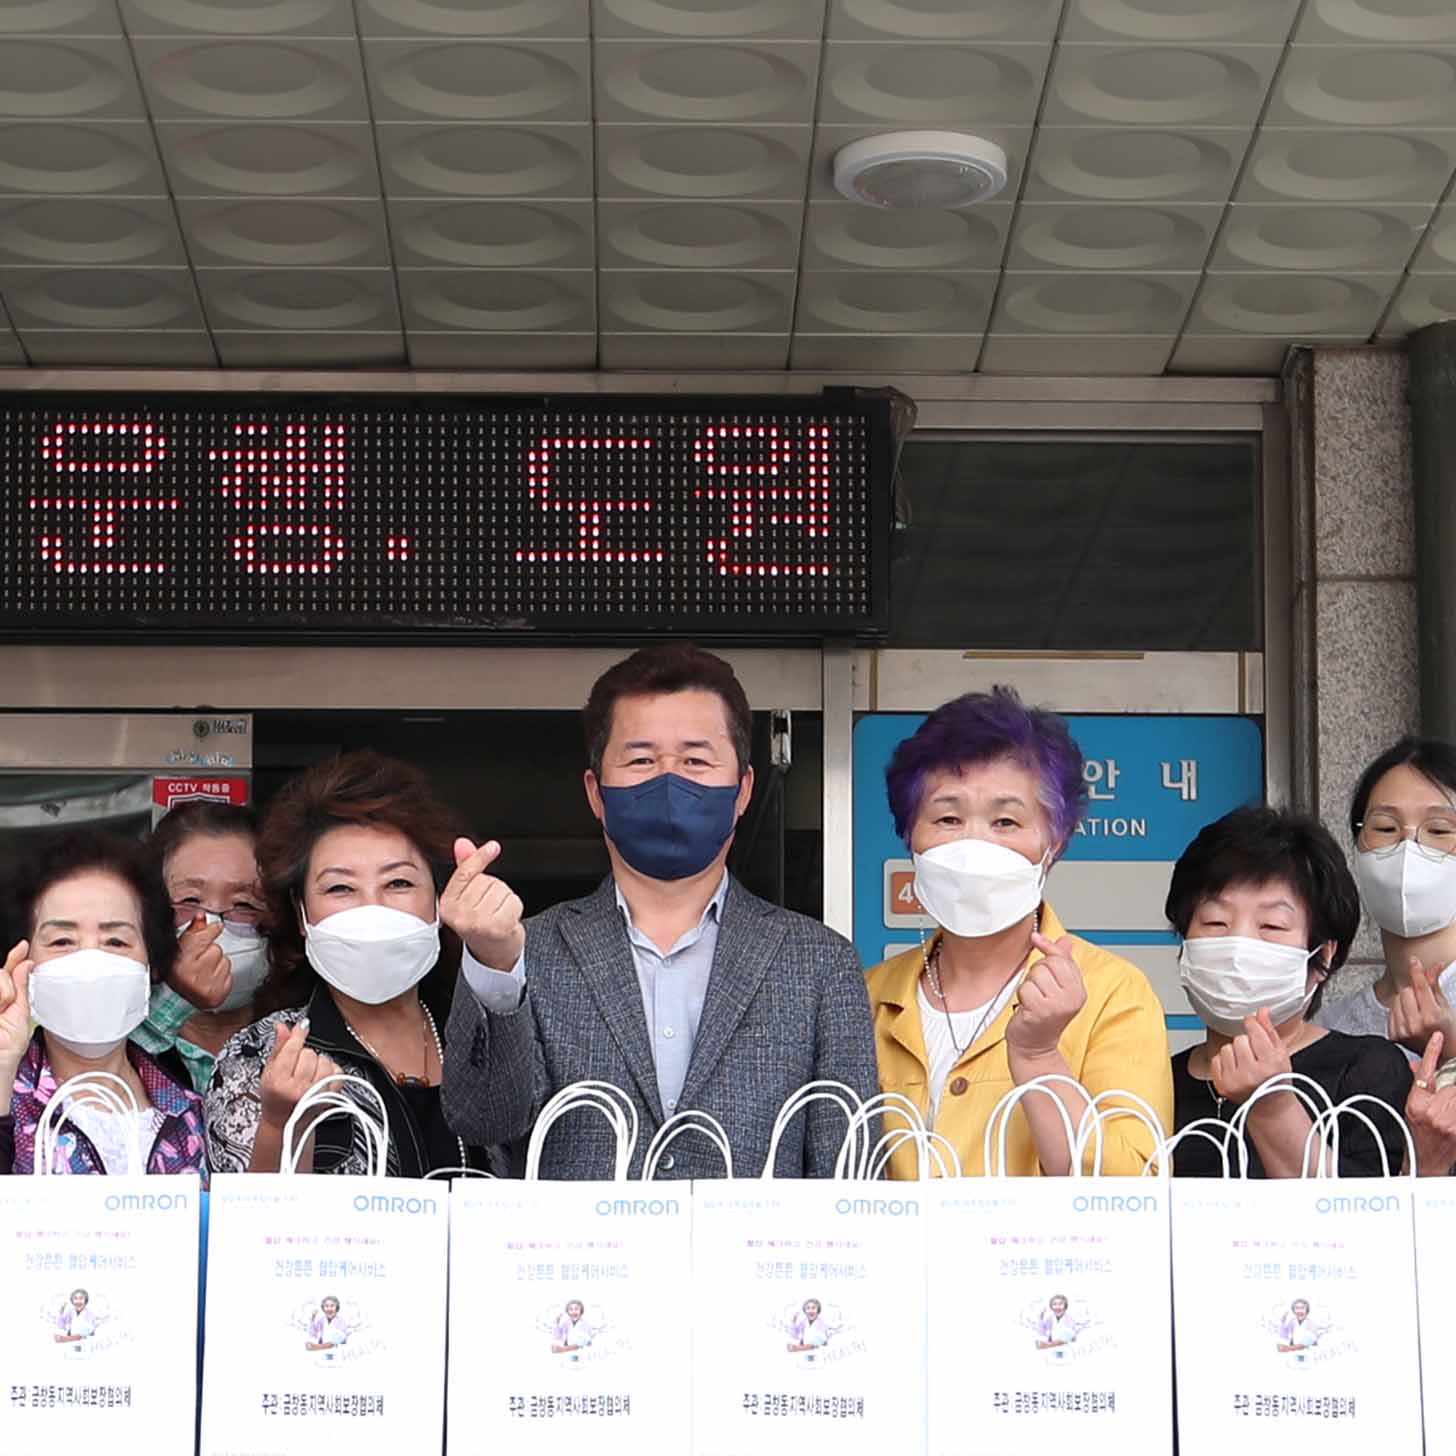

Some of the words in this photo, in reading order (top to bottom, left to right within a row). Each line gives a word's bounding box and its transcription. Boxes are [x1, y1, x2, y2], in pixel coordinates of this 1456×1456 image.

[514, 424, 831, 577] 도원
[167, 783, 197, 793] CCTV
[1074, 817, 1146, 837] ATION
[104, 1193, 188, 1211] OMRON
[352, 1194, 437, 1217] OMRON
[595, 1199, 680, 1217] OMRON
[834, 1198, 920, 1217] OMRON
[1072, 1195, 1158, 1213] OMRON
[1315, 1195, 1401, 1215] OMRON
